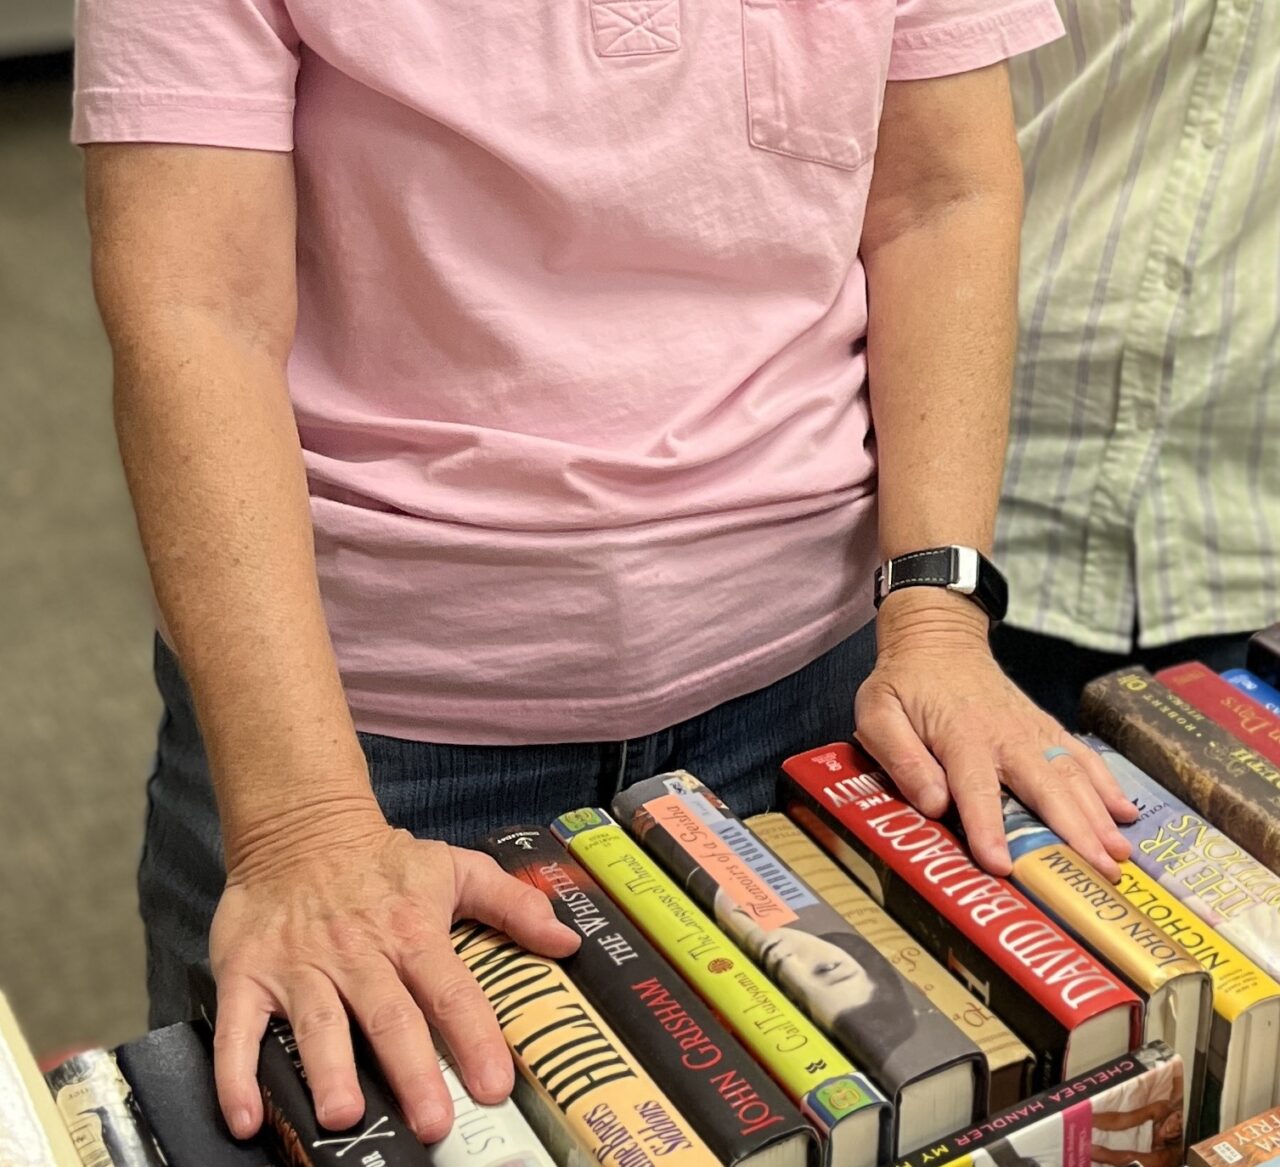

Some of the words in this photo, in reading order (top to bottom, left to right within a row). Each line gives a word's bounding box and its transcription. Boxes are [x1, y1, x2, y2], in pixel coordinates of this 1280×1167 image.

[1143, 693, 1198, 733] ROBERT
[1219, 694, 1271, 733] Days
[667, 805, 712, 843] Geisha
[856, 793, 895, 811] THE
[698, 848, 731, 863] of
[866, 809, 1030, 929] BALDACCI
[1138, 827, 1203, 877] FAR
[539, 862, 614, 939] WHISTLER
[726, 859, 784, 916] Memoirs
[1040, 850, 1130, 922] GRISHAM
[1183, 870, 1251, 922] THE
[658, 893, 705, 944] Language
[1114, 872, 1231, 972] NICHOLAS
[1124, 919, 1190, 968] JOHN
[597, 932, 640, 967] THE
[687, 935, 722, 962] The
[997, 918, 1121, 1011] DAVID
[450, 917, 570, 1033] TOWN
[630, 975, 724, 1071] GRISHAM
[733, 971, 785, 1036] Tsukiyama
[513, 1002, 638, 1116] HILL
[775, 1020, 808, 1053] Gail
[709, 1069, 785, 1137] JOHN
[1048, 1059, 1136, 1102] CHELSEA
[633, 1098, 694, 1157] Siddons
[953, 1100, 1045, 1147] HANDLER
[920, 1143, 950, 1164] MY
